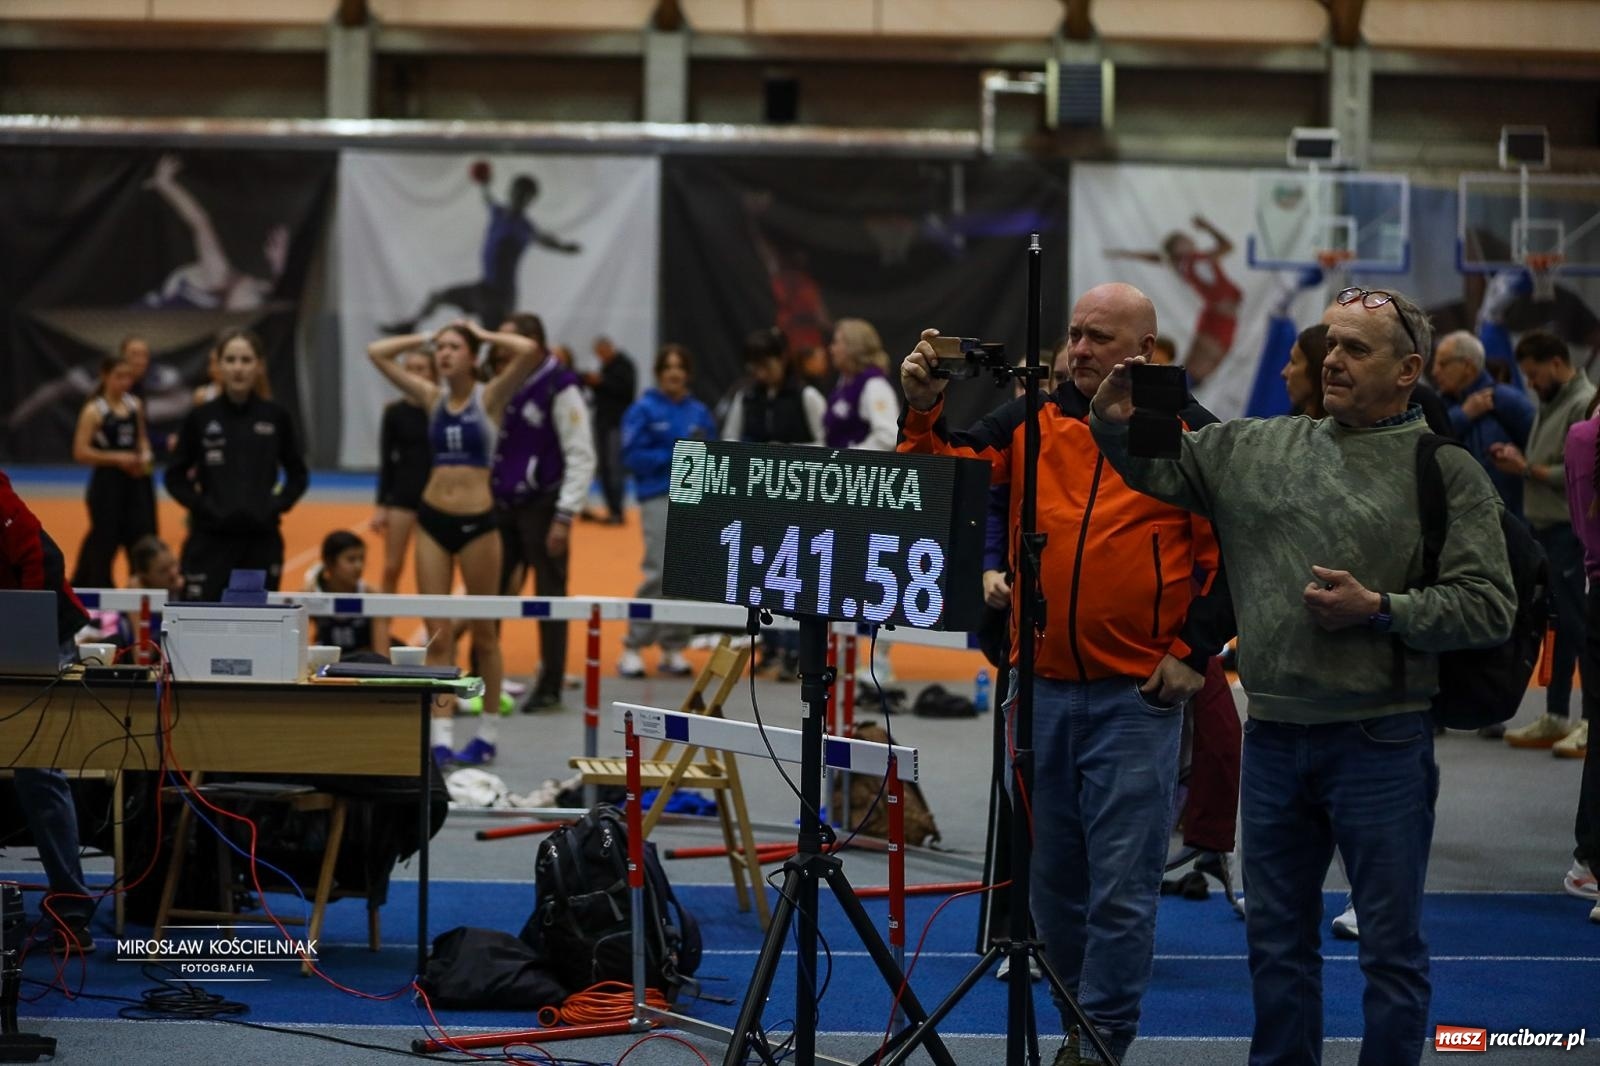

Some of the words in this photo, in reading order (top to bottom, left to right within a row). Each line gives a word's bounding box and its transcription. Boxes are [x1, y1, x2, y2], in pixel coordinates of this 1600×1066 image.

[704, 454, 736, 495] M.
[747, 450, 922, 511] PUSTÓWKA
[720, 520, 945, 628] 1:41.58
